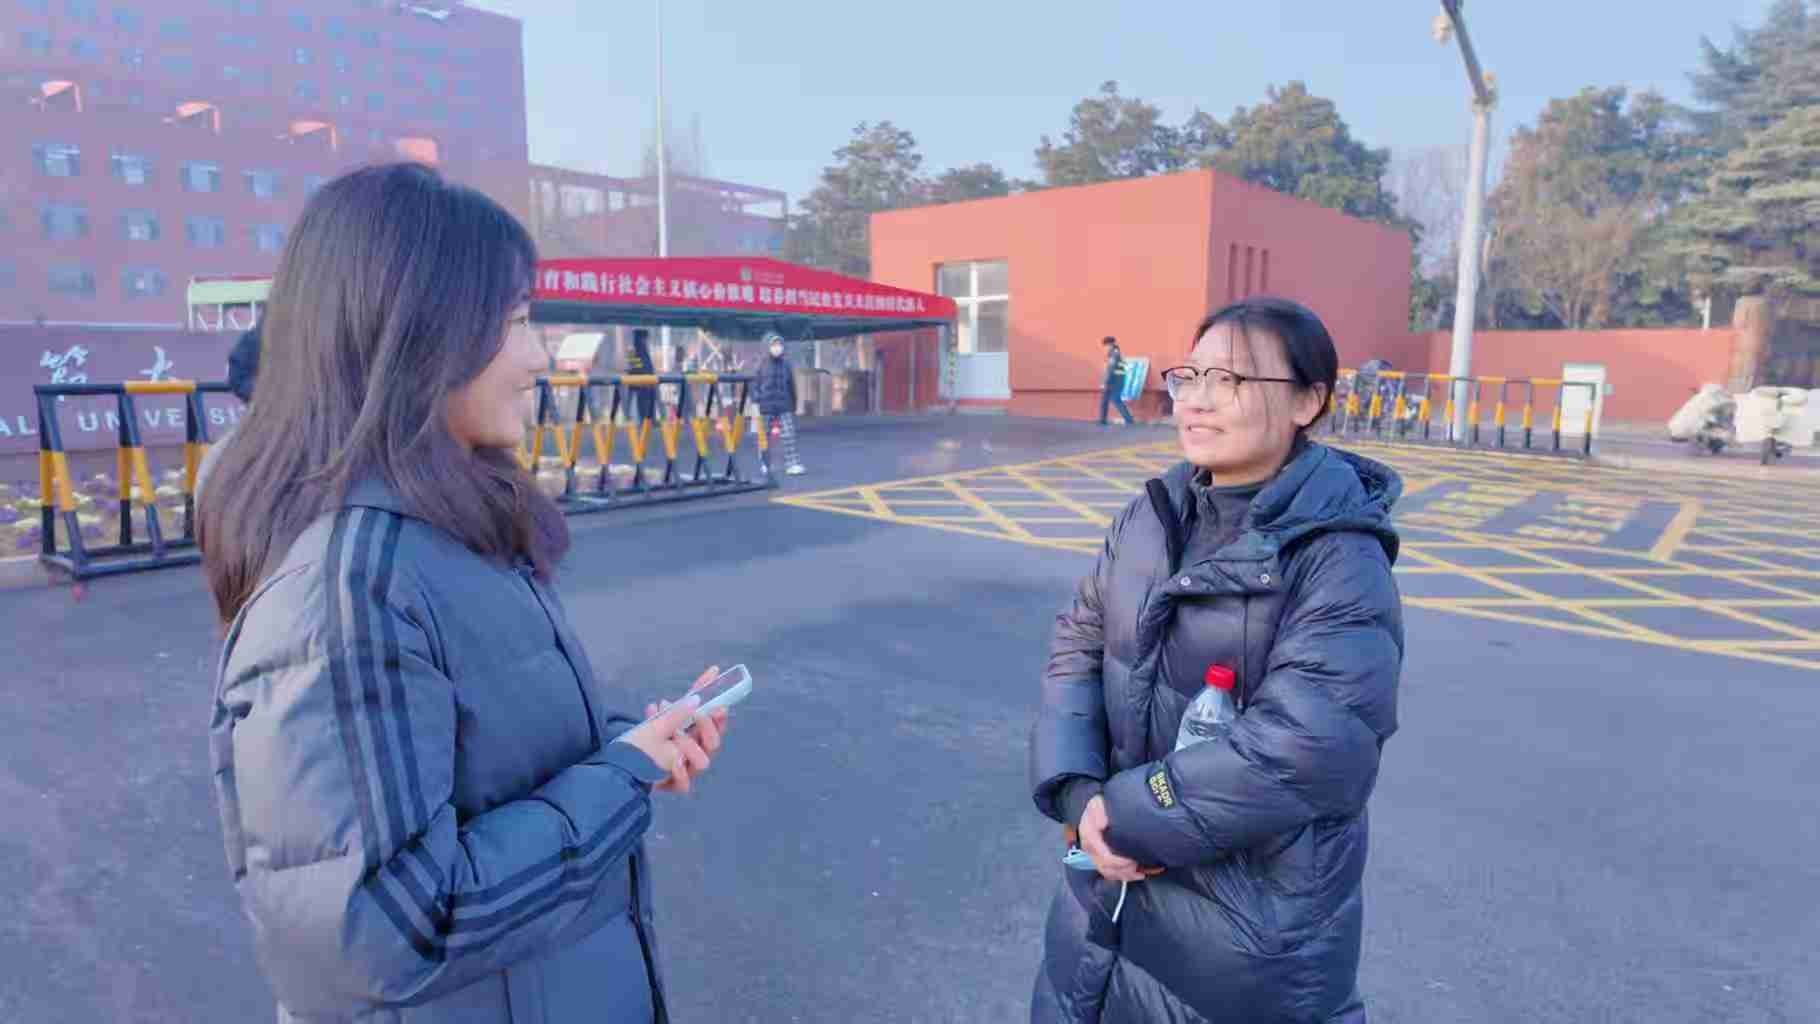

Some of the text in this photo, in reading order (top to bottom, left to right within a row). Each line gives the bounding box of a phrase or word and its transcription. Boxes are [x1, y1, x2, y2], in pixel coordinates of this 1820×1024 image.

[535, 268, 755, 304] 育和践行社会主义核心价值观
